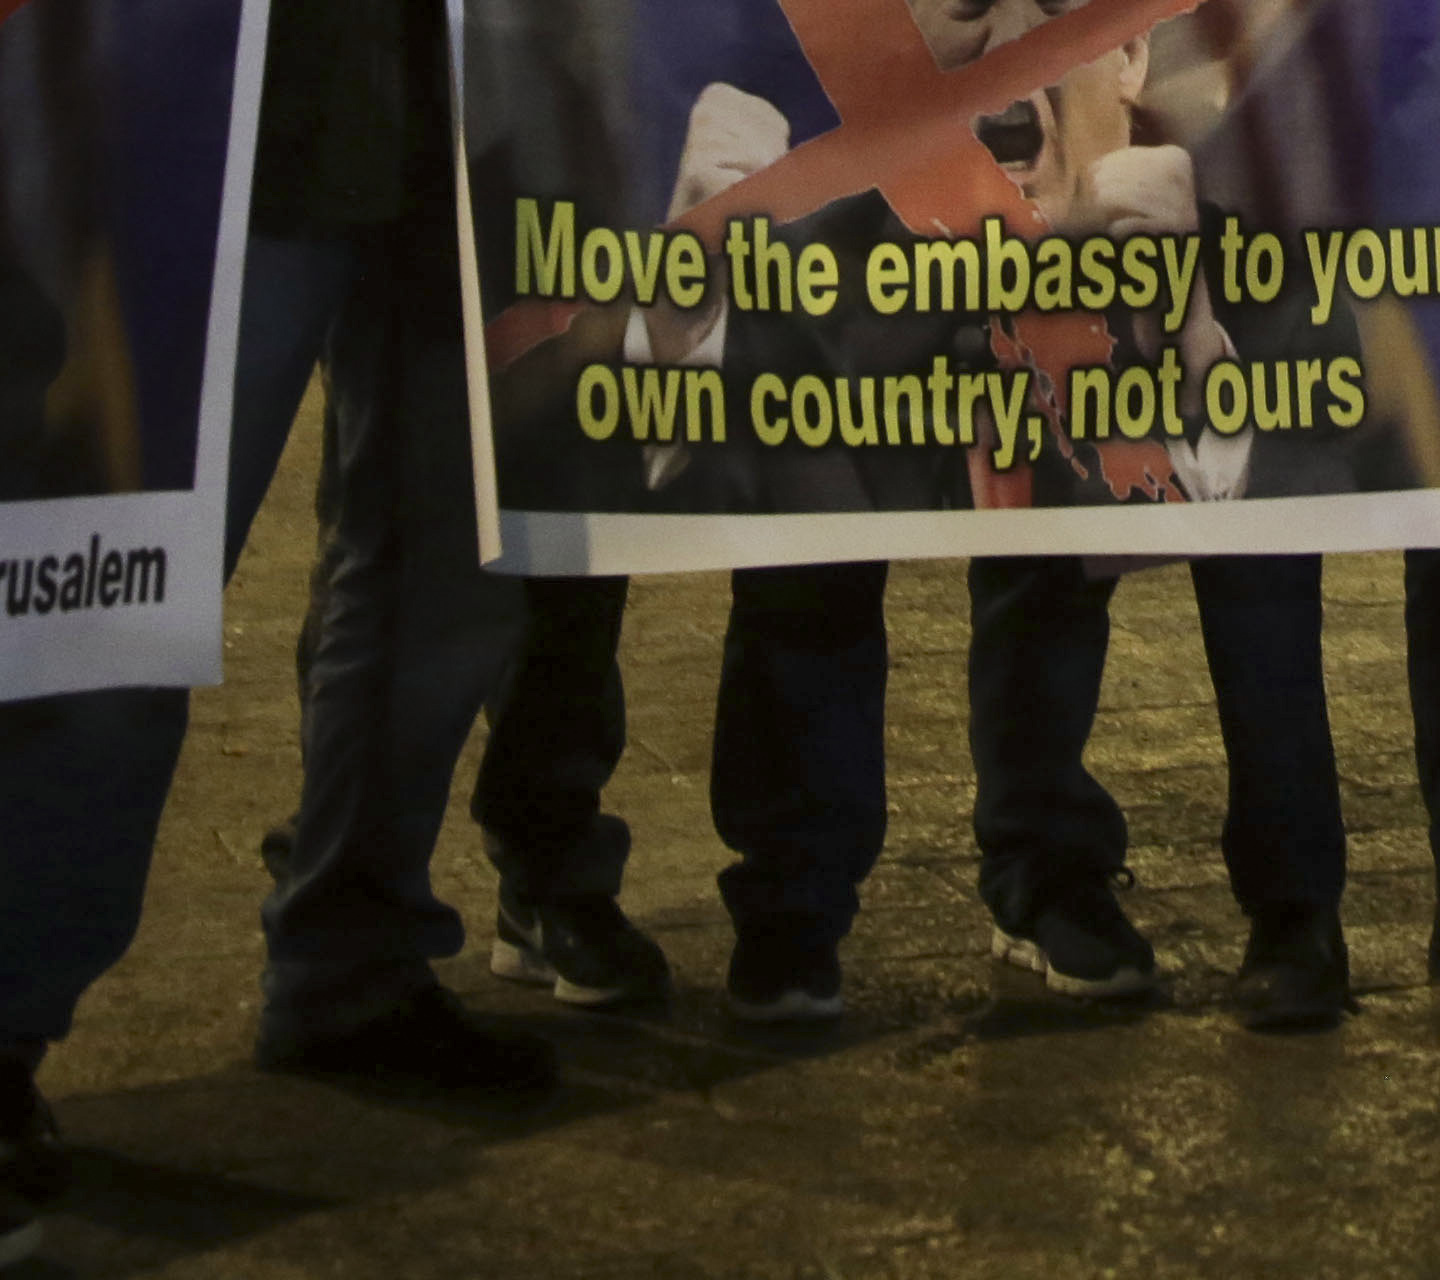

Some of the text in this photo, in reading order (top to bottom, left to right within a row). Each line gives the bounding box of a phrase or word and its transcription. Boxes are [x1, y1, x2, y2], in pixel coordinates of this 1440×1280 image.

[515, 197, 706, 309] Move
[726, 217, 839, 316] the
[865, 218, 1201, 330] embassy
[1220, 216, 1285, 303] to
[576, 348, 1364, 470] own country, not ours
